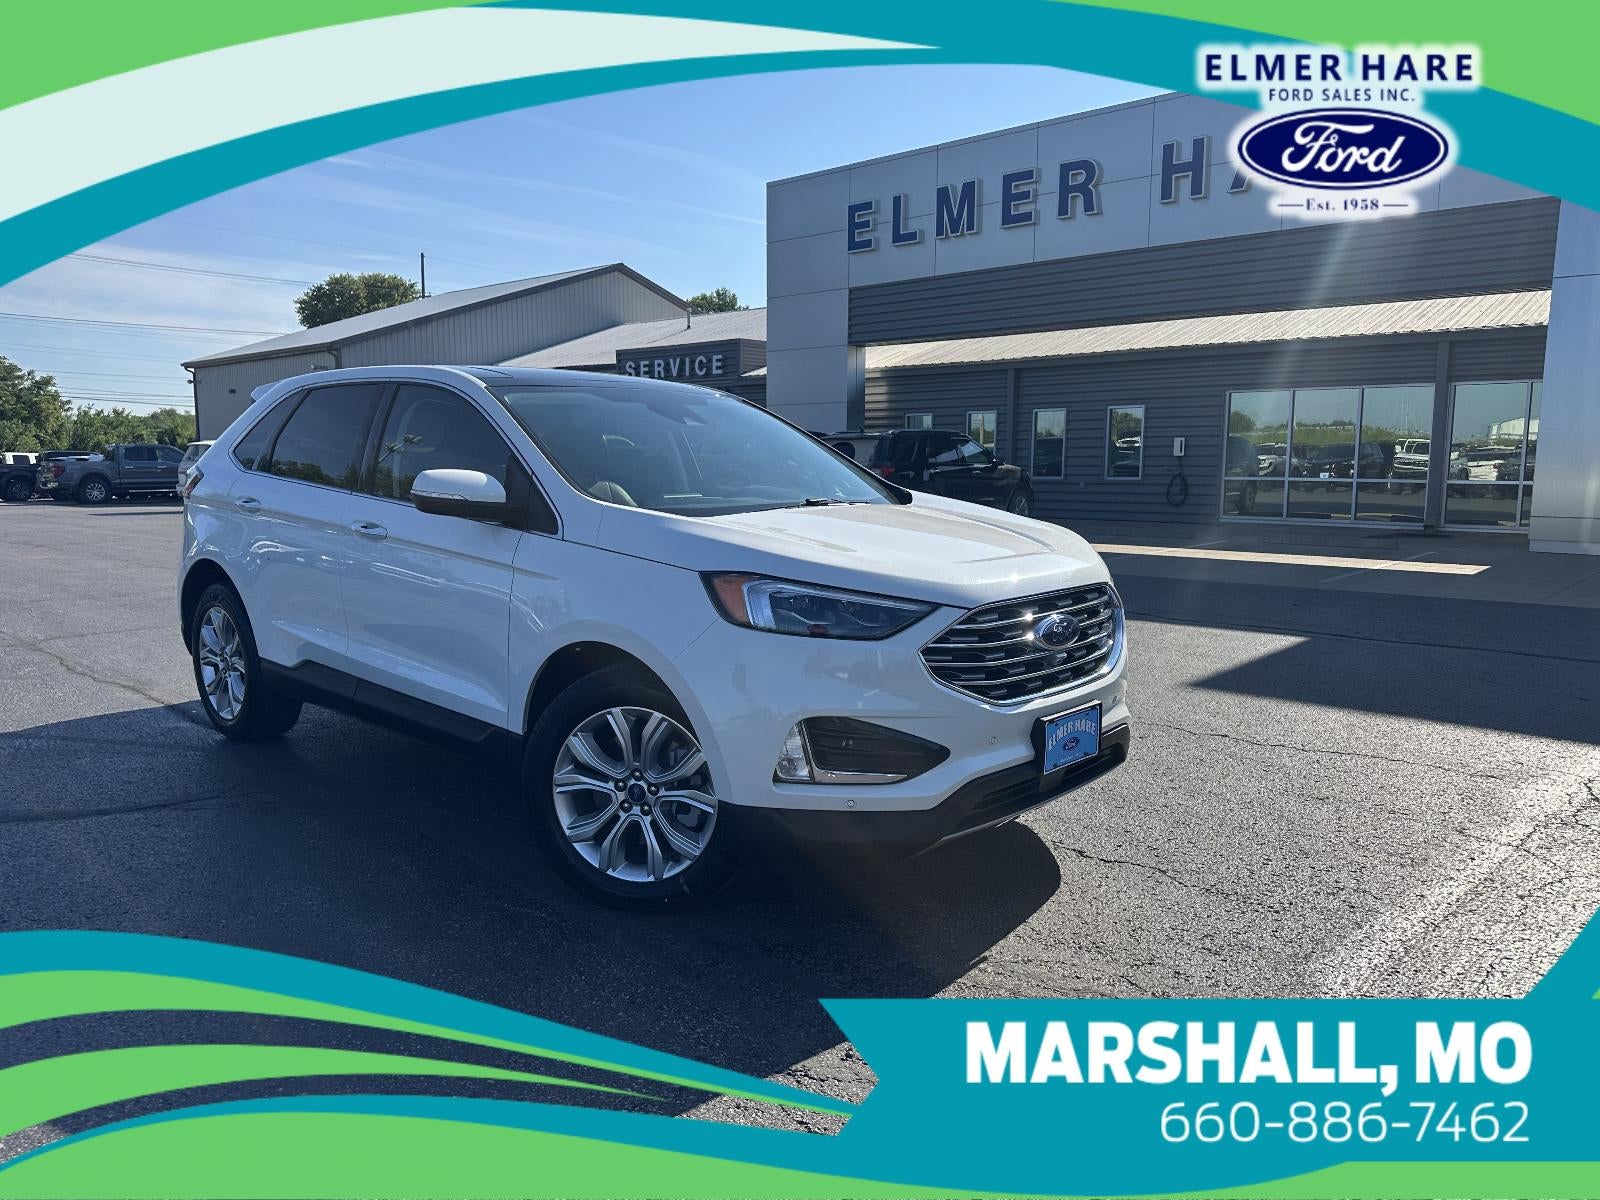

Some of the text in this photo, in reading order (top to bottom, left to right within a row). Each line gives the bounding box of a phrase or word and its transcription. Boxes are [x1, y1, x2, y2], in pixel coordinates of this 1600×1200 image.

[847, 157, 1103, 254] ELMER
[625, 354, 724, 378] SERVICE
[1048, 721, 1074, 752] ELMER
[1074, 719, 1096, 736] HARE
